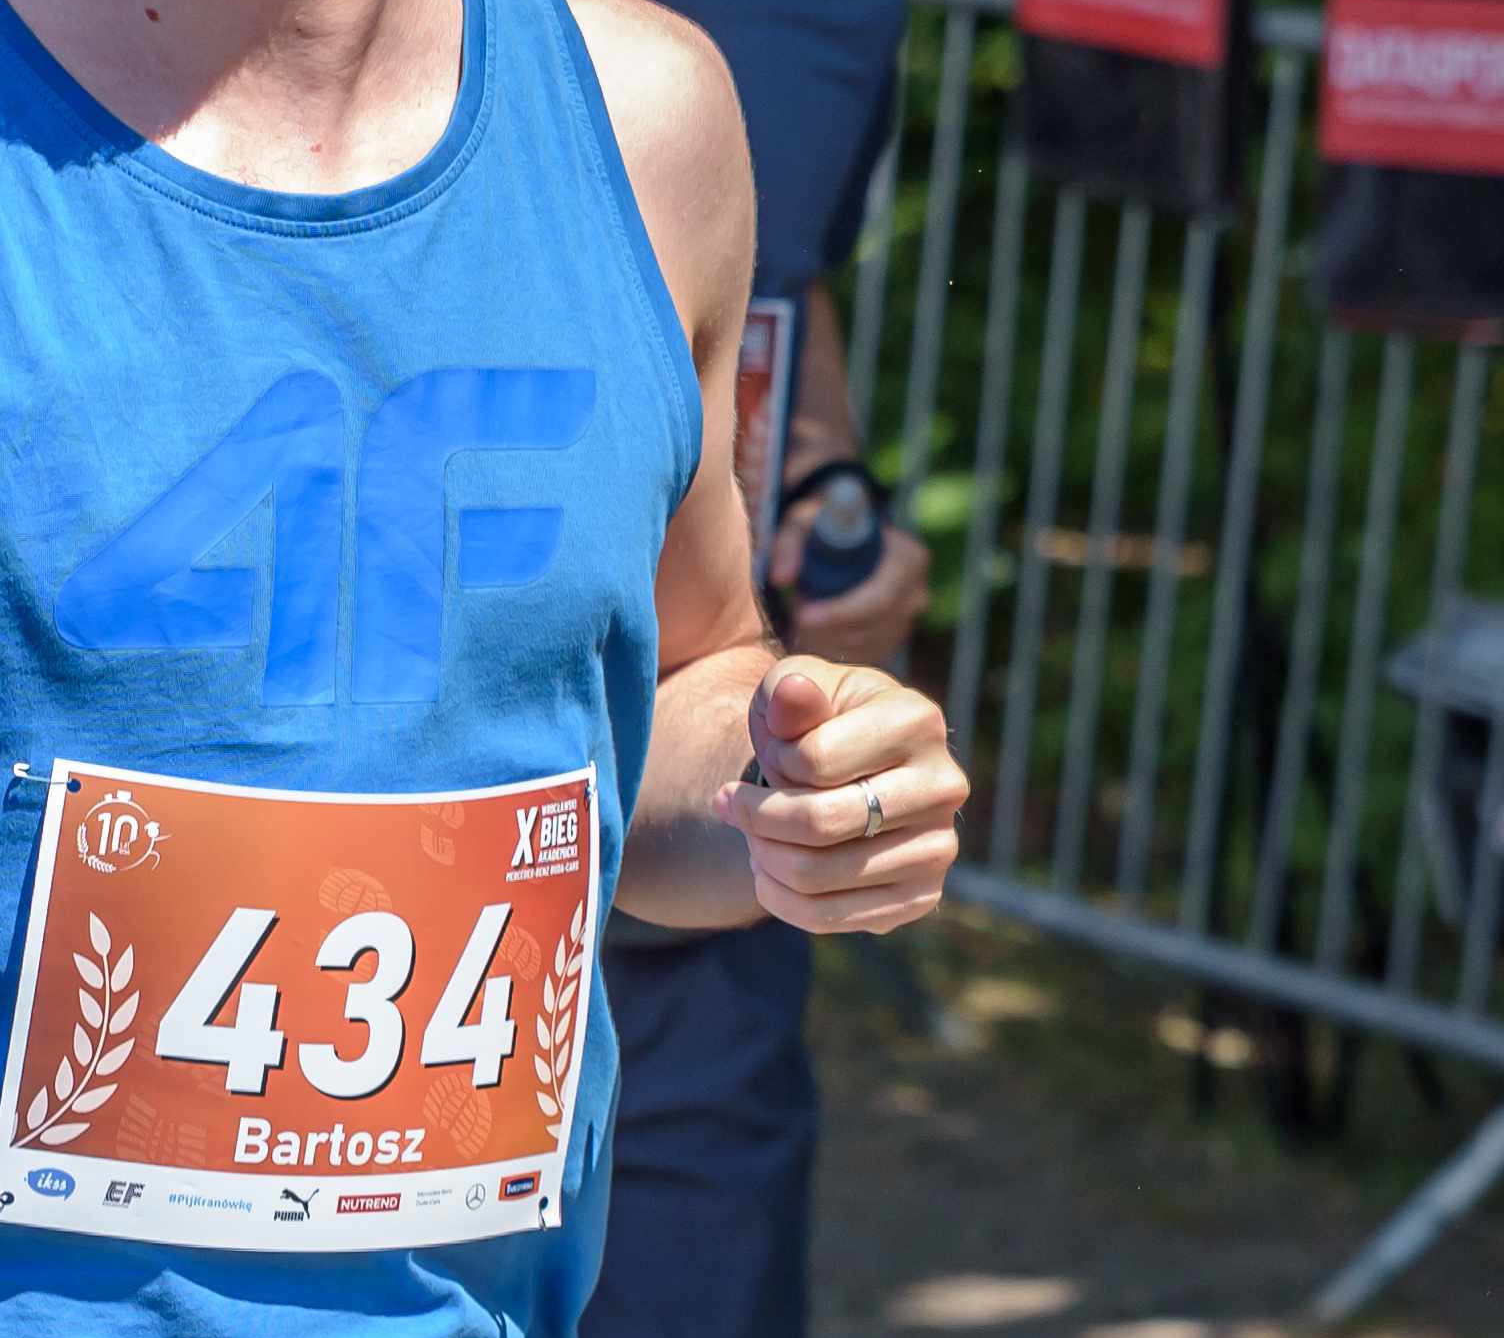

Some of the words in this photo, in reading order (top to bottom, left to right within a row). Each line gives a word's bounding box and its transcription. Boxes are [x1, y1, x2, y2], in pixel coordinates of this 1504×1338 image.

[53, 368, 595, 707] 4F
[97, 812, 139, 856] 10
[511, 806, 539, 867] X
[539, 811, 578, 848] BIEG
[154, 901, 517, 1099] 434
[233, 1116, 426, 1167] Bartosz
[105, 1180, 145, 1204] EF
[340, 1195, 398, 1212] NUTREND
